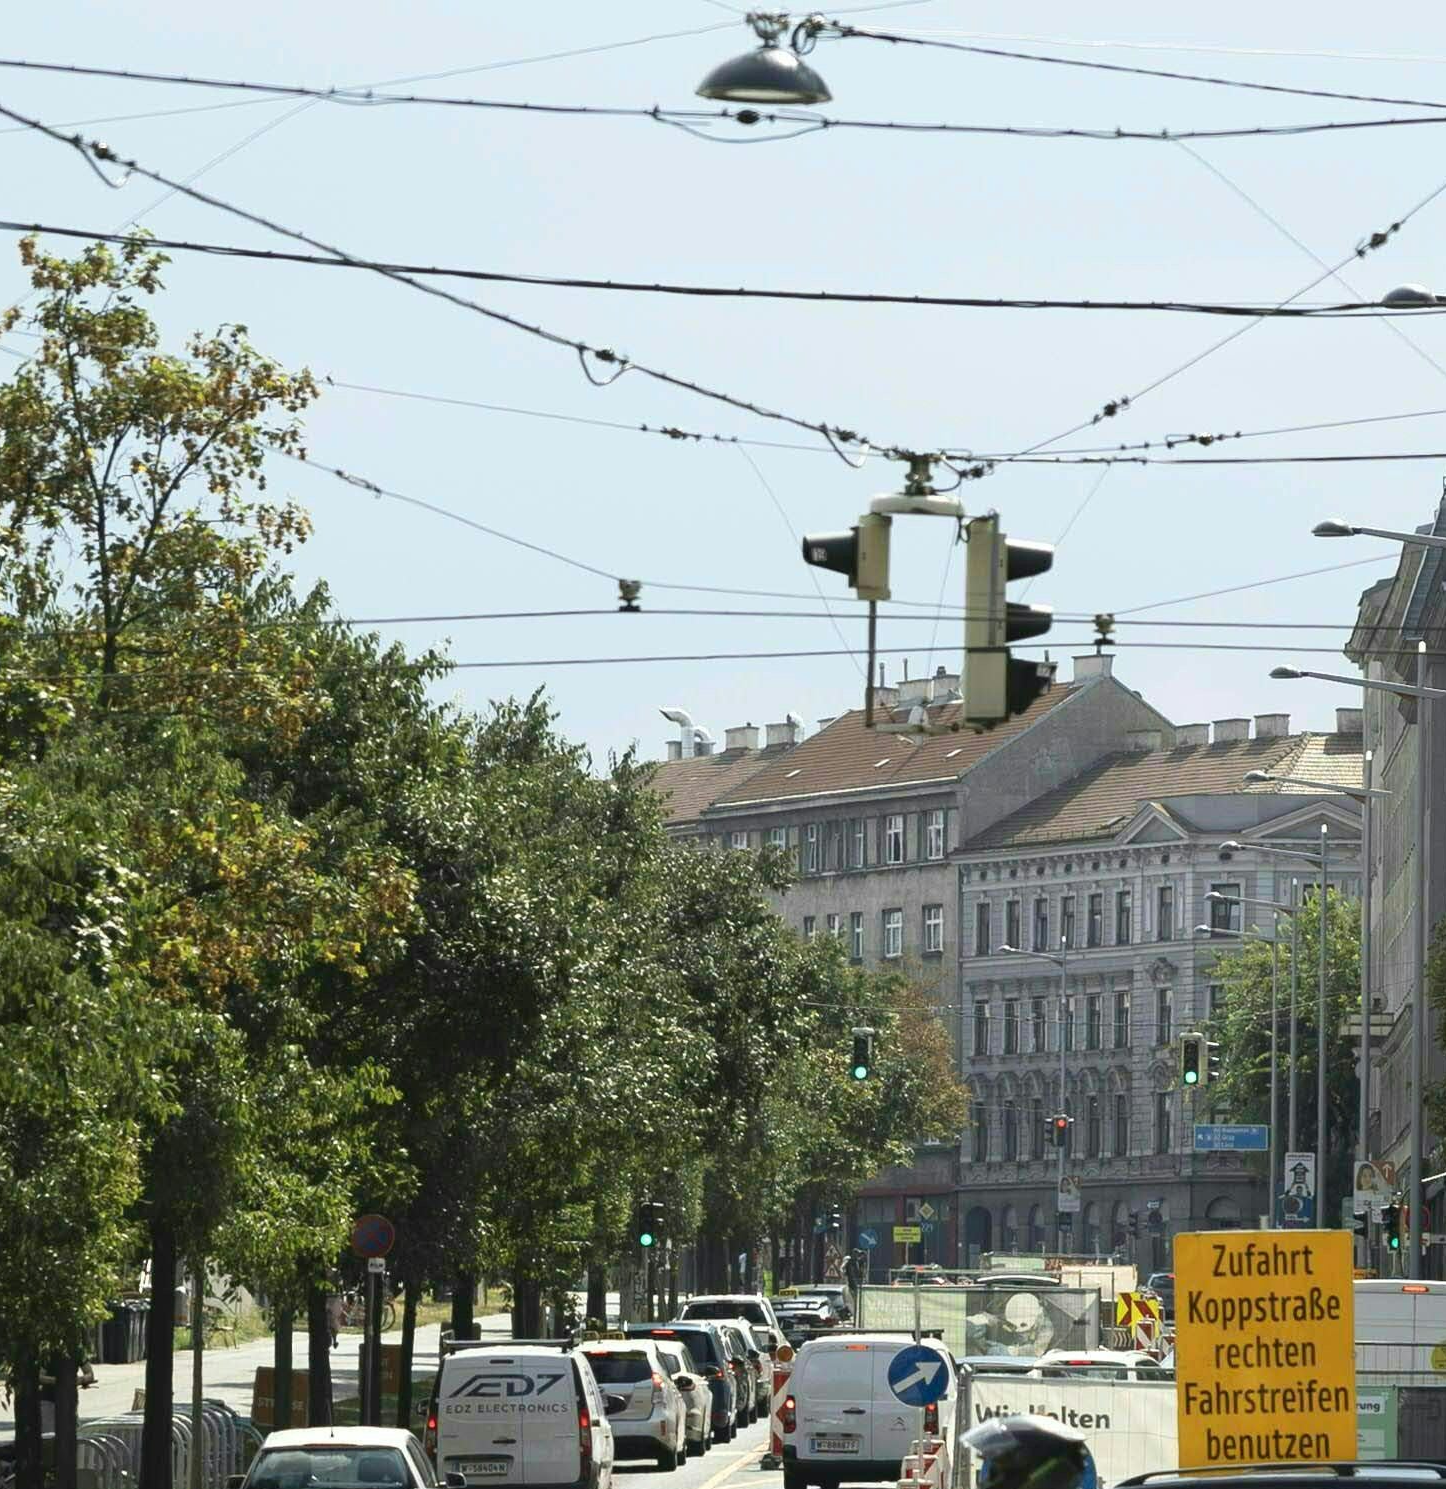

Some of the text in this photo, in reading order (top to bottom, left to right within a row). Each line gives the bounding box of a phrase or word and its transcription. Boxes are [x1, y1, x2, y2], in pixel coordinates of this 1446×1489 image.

[1212, 1243, 1313, 1277] Zufahrt
[1188, 1287, 1341, 1330] Koppstraße
[1215, 1336, 1316, 1369] rechten
[446, 1403, 569, 1414] EDZ ELECTRONICS
[1184, 1379, 1350, 1416] Fahrstreifen
[1206, 1428, 1331, 1461] benutzen
